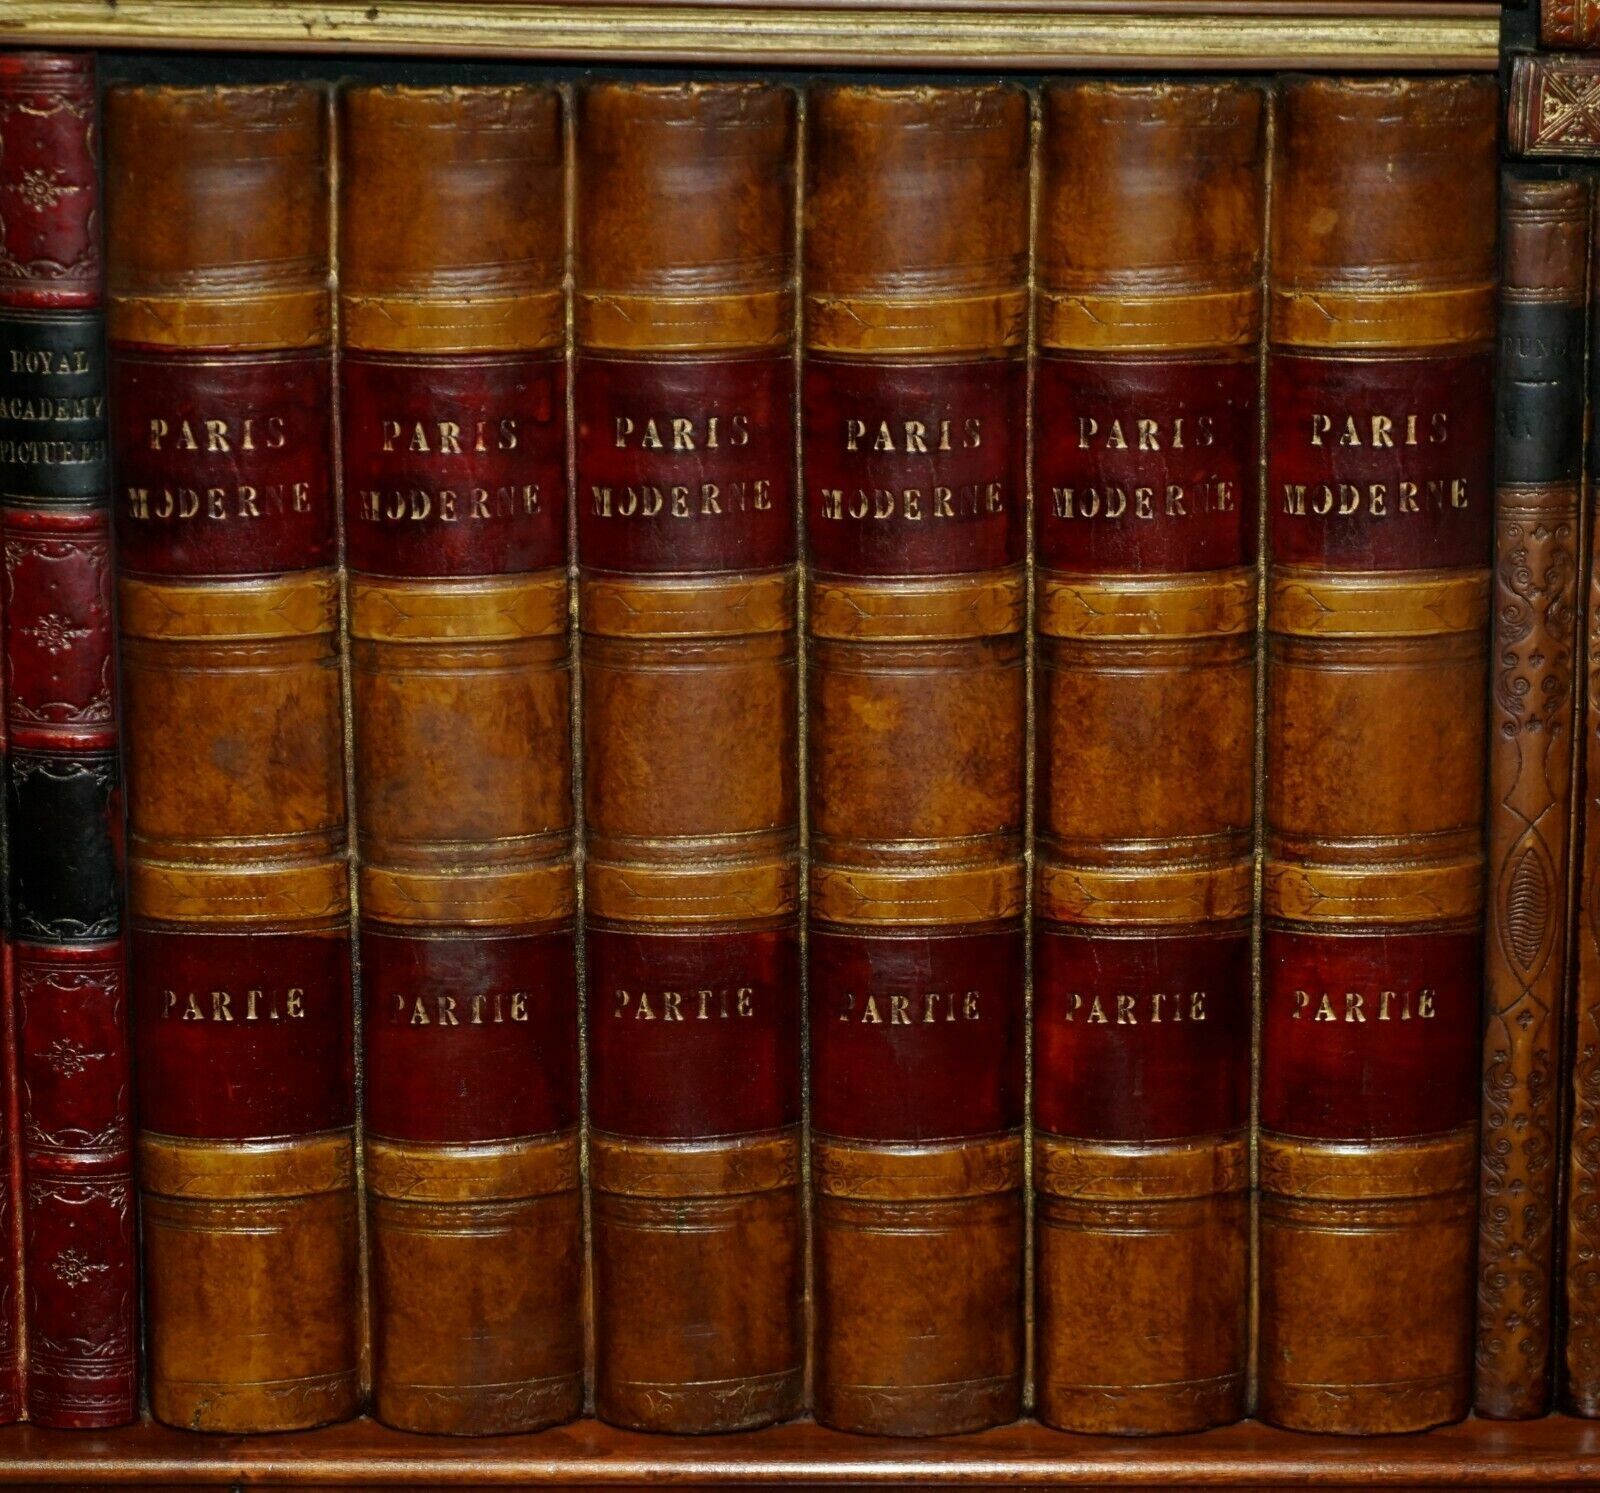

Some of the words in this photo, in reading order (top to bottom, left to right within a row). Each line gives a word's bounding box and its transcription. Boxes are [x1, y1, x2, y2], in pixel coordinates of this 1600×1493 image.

[9, 348, 91, 376] ROYAL
[0, 396, 105, 422] ACADEMY
[149, 416, 288, 454] PARIS
[382, 418, 518, 454] PARIS
[615, 414, 749, 450] PARIS
[846, 417, 981, 453] PARIS
[1077, 415, 1214, 452] PARIS
[1310, 411, 1448, 448] PARIS
[128, 481, 312, 520] MODERNE
[359, 483, 541, 522] MODERNE
[591, 478, 772, 518] MODERNE
[1282, 476, 1468, 516] MODERNE
[162, 986, 306, 1022] PARTIE
[390, 989, 530, 1026] PARTIE
[613, 985, 754, 1022] PARTIE
[839, 988, 981, 1025] PARTIE
[1064, 989, 1207, 1026] PARTIE
[1292, 986, 1437, 1022] PARTIE
